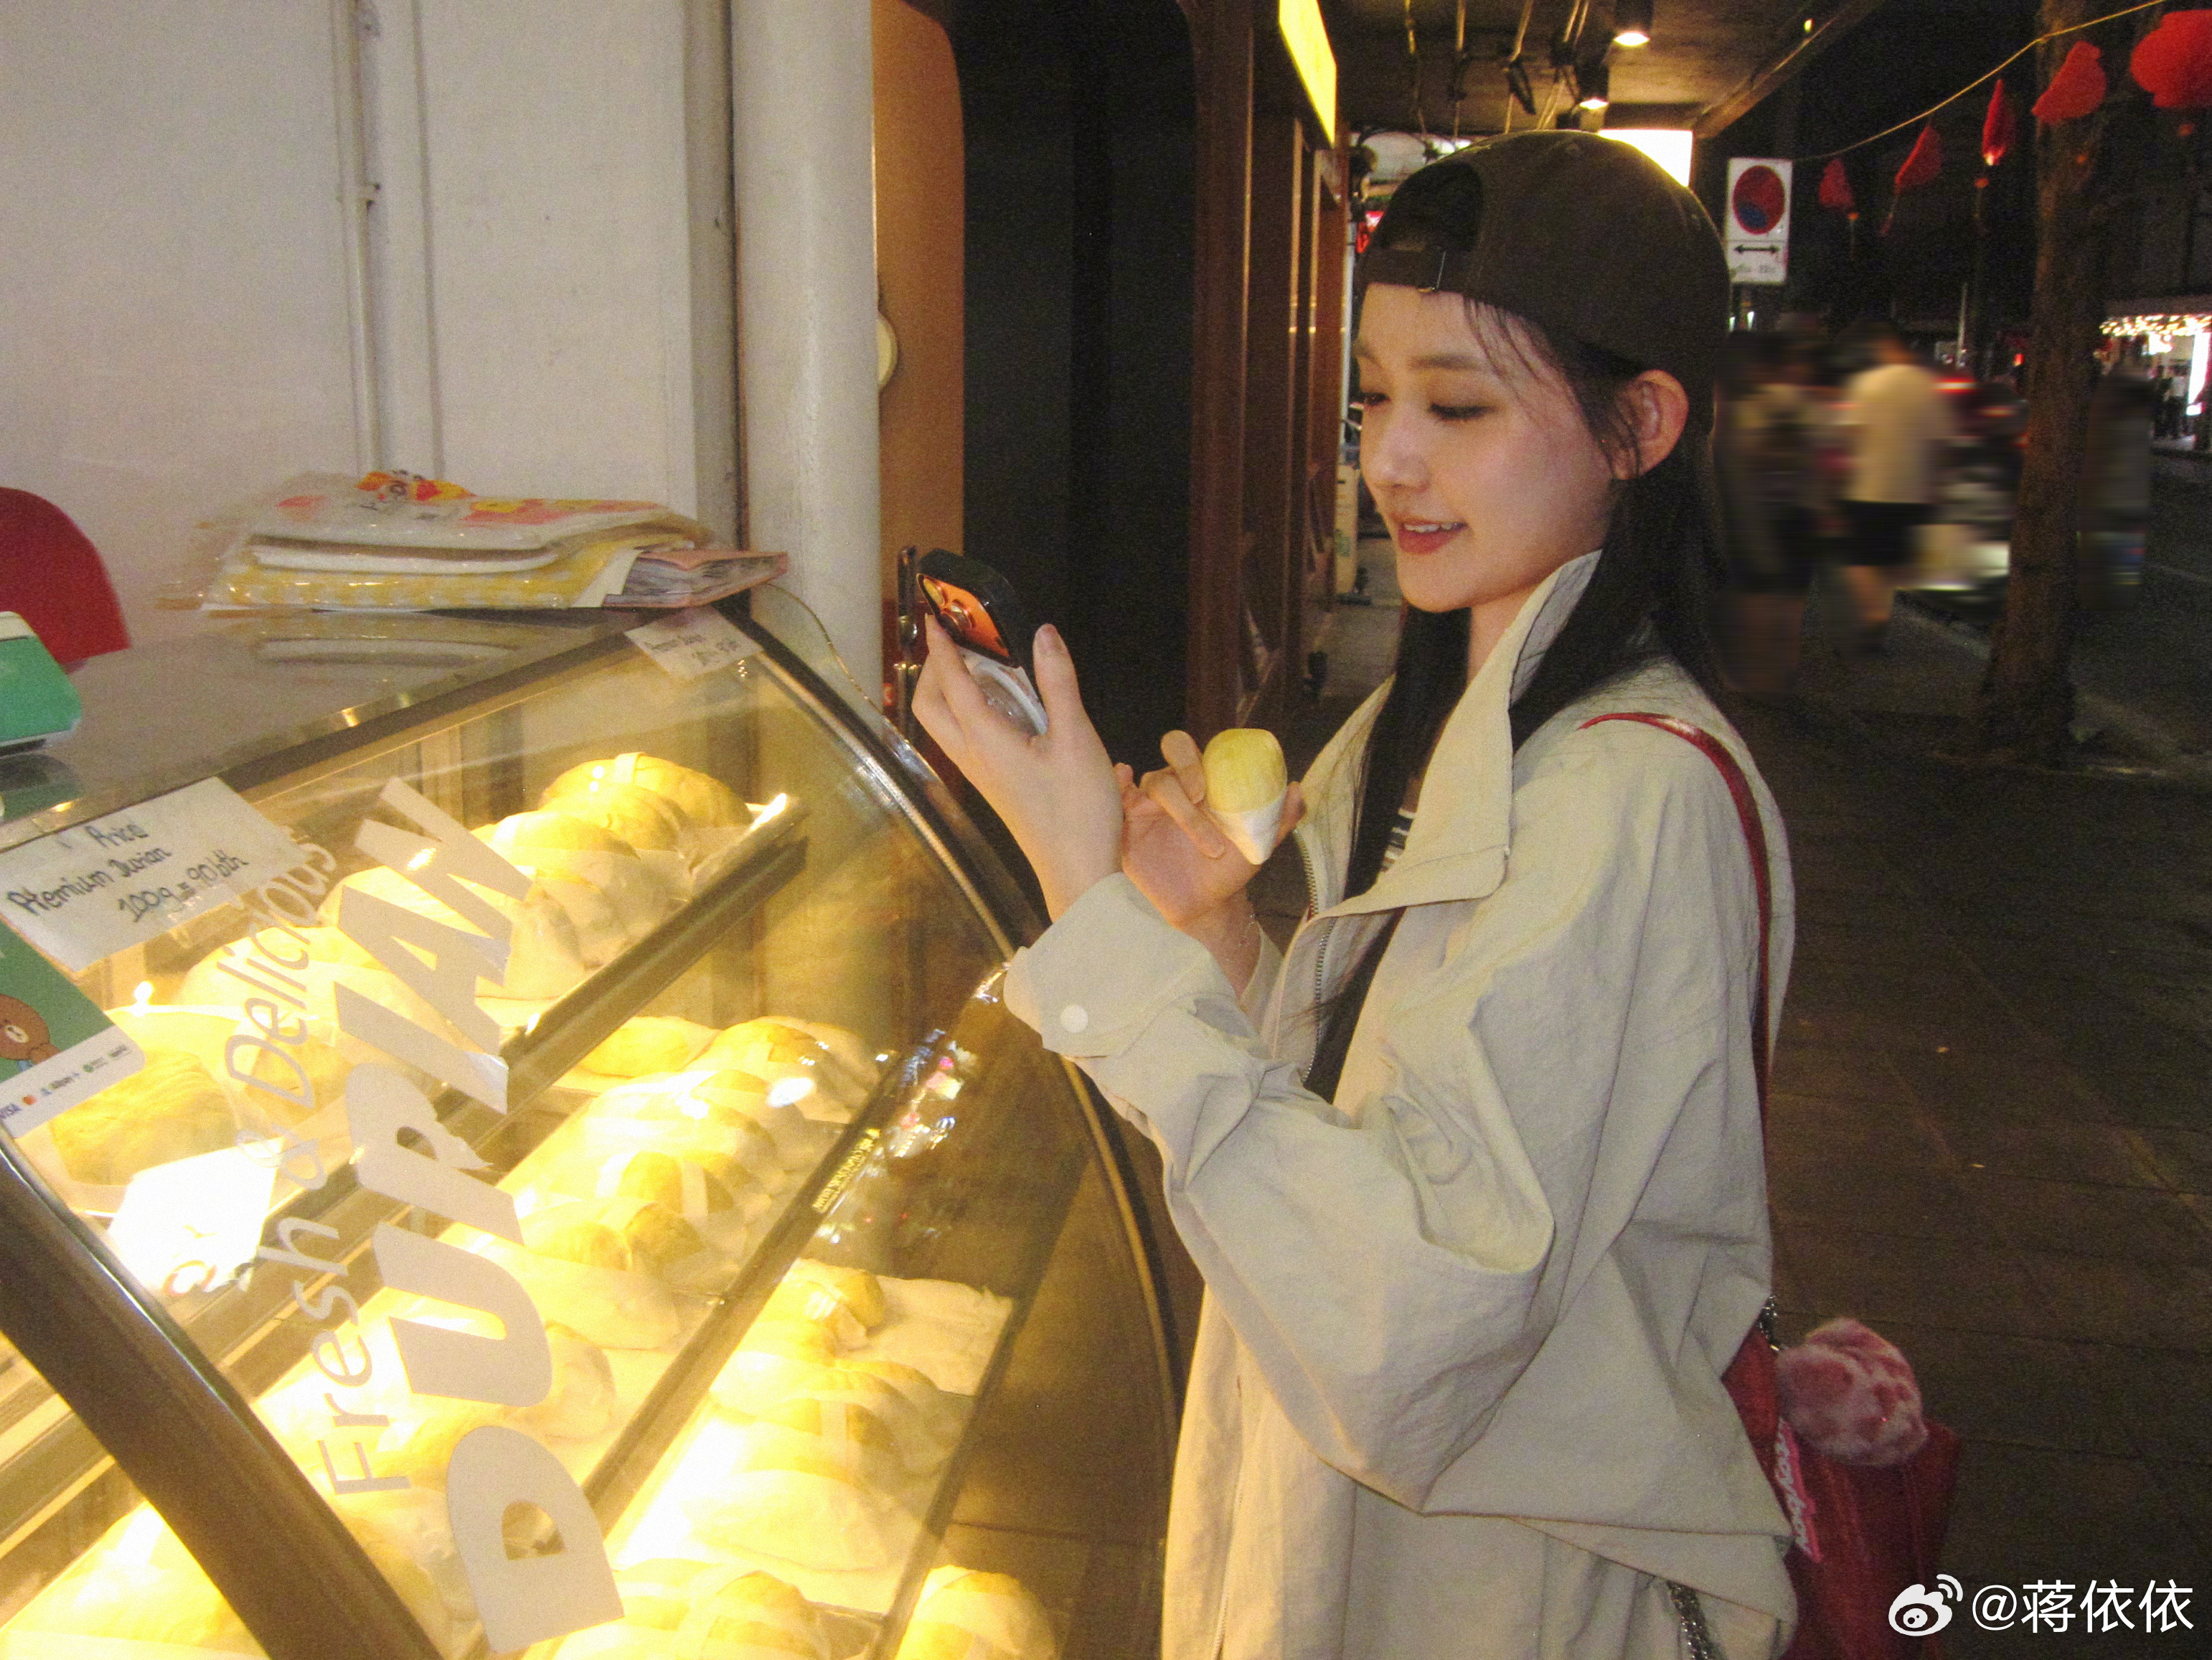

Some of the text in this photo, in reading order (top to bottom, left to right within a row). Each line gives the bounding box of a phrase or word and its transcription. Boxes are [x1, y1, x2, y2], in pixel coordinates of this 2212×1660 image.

[216, 827, 337, 1110] Delicious
[255, 1216, 412, 1496] Fresh
[332, 776, 626, 1655] DURIAN
